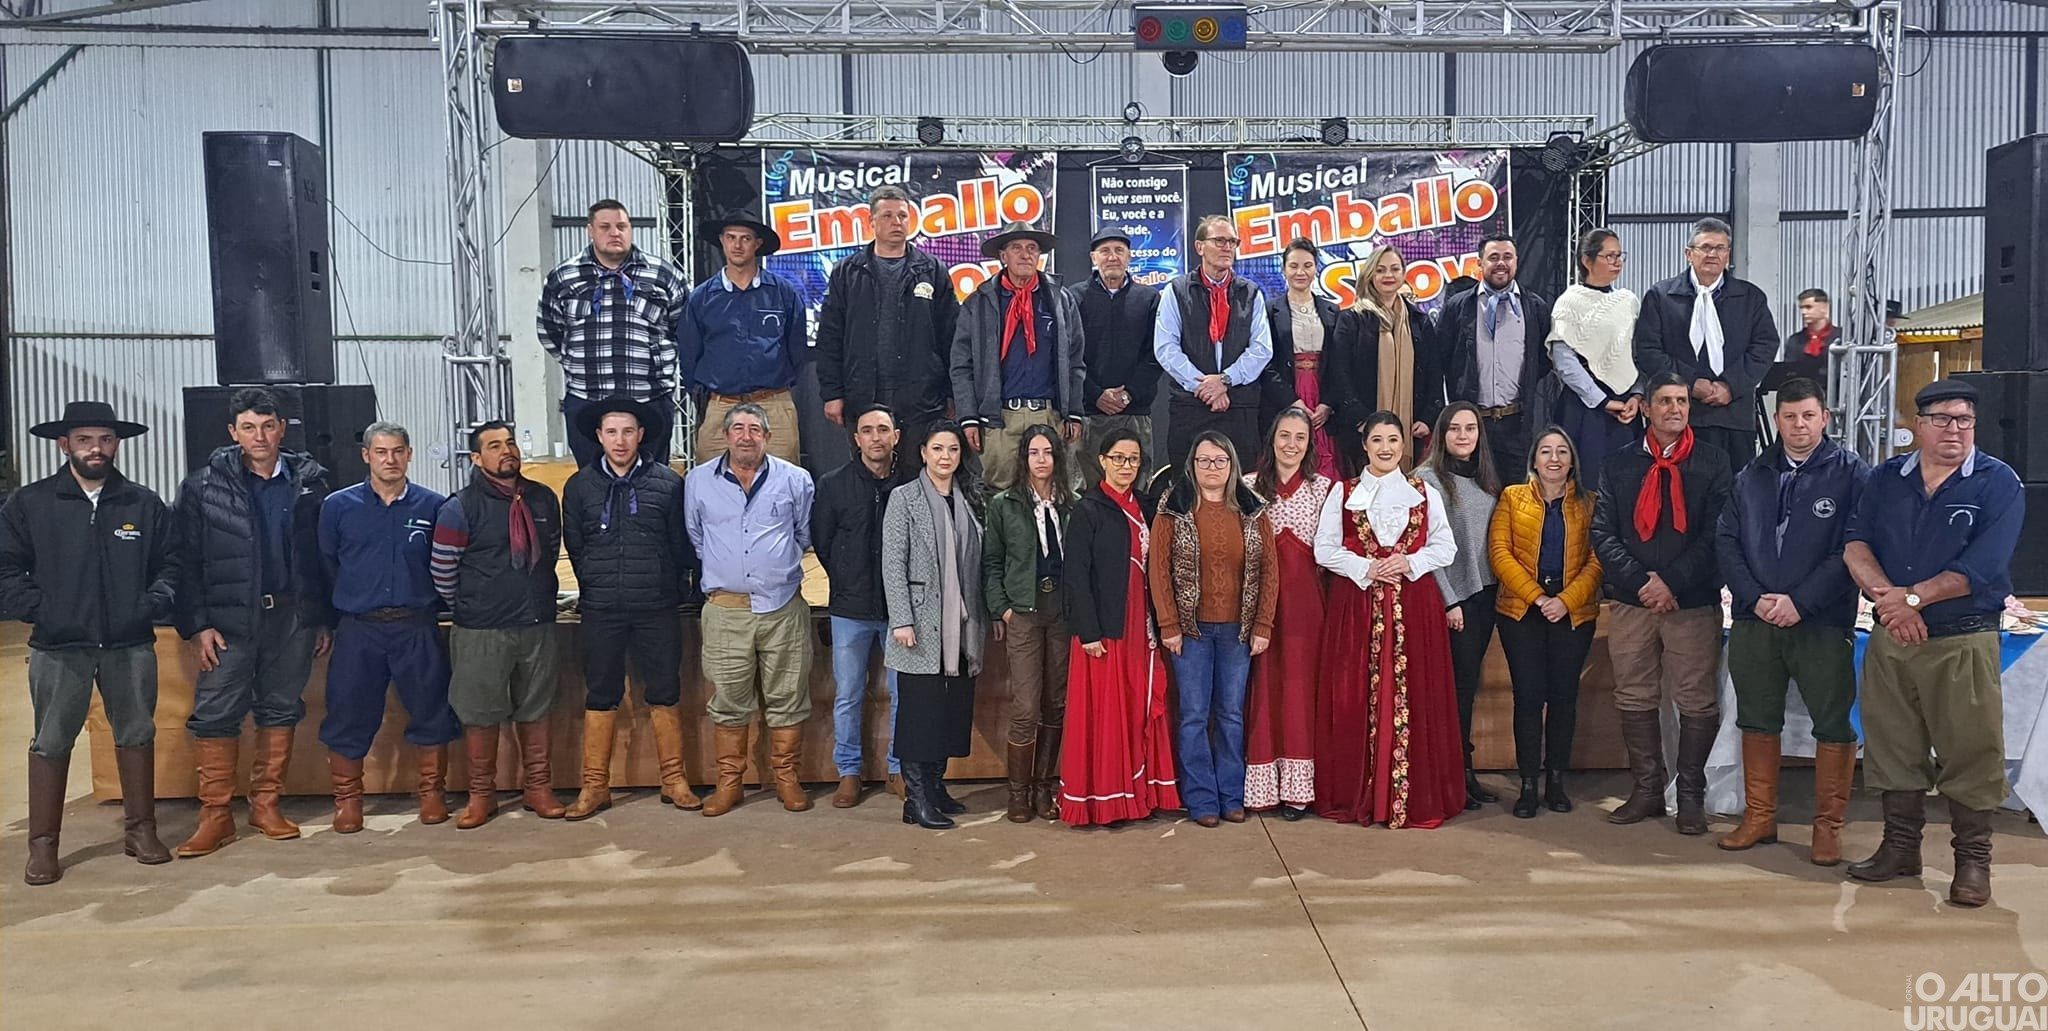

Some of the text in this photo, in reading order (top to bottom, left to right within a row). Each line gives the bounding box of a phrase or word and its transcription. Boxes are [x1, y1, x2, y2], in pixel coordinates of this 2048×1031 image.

[789, 156, 911, 196] Musical
[1101, 176, 1168, 191] Não consigo
[1250, 157, 1368, 200] Musical
[1101, 191, 1183, 204] viver sem você.
[1102, 208, 1165, 221] Eu, você e a
[1233, 172, 1498, 260] Emballo
[1130, 246, 1177, 258] cesso do
